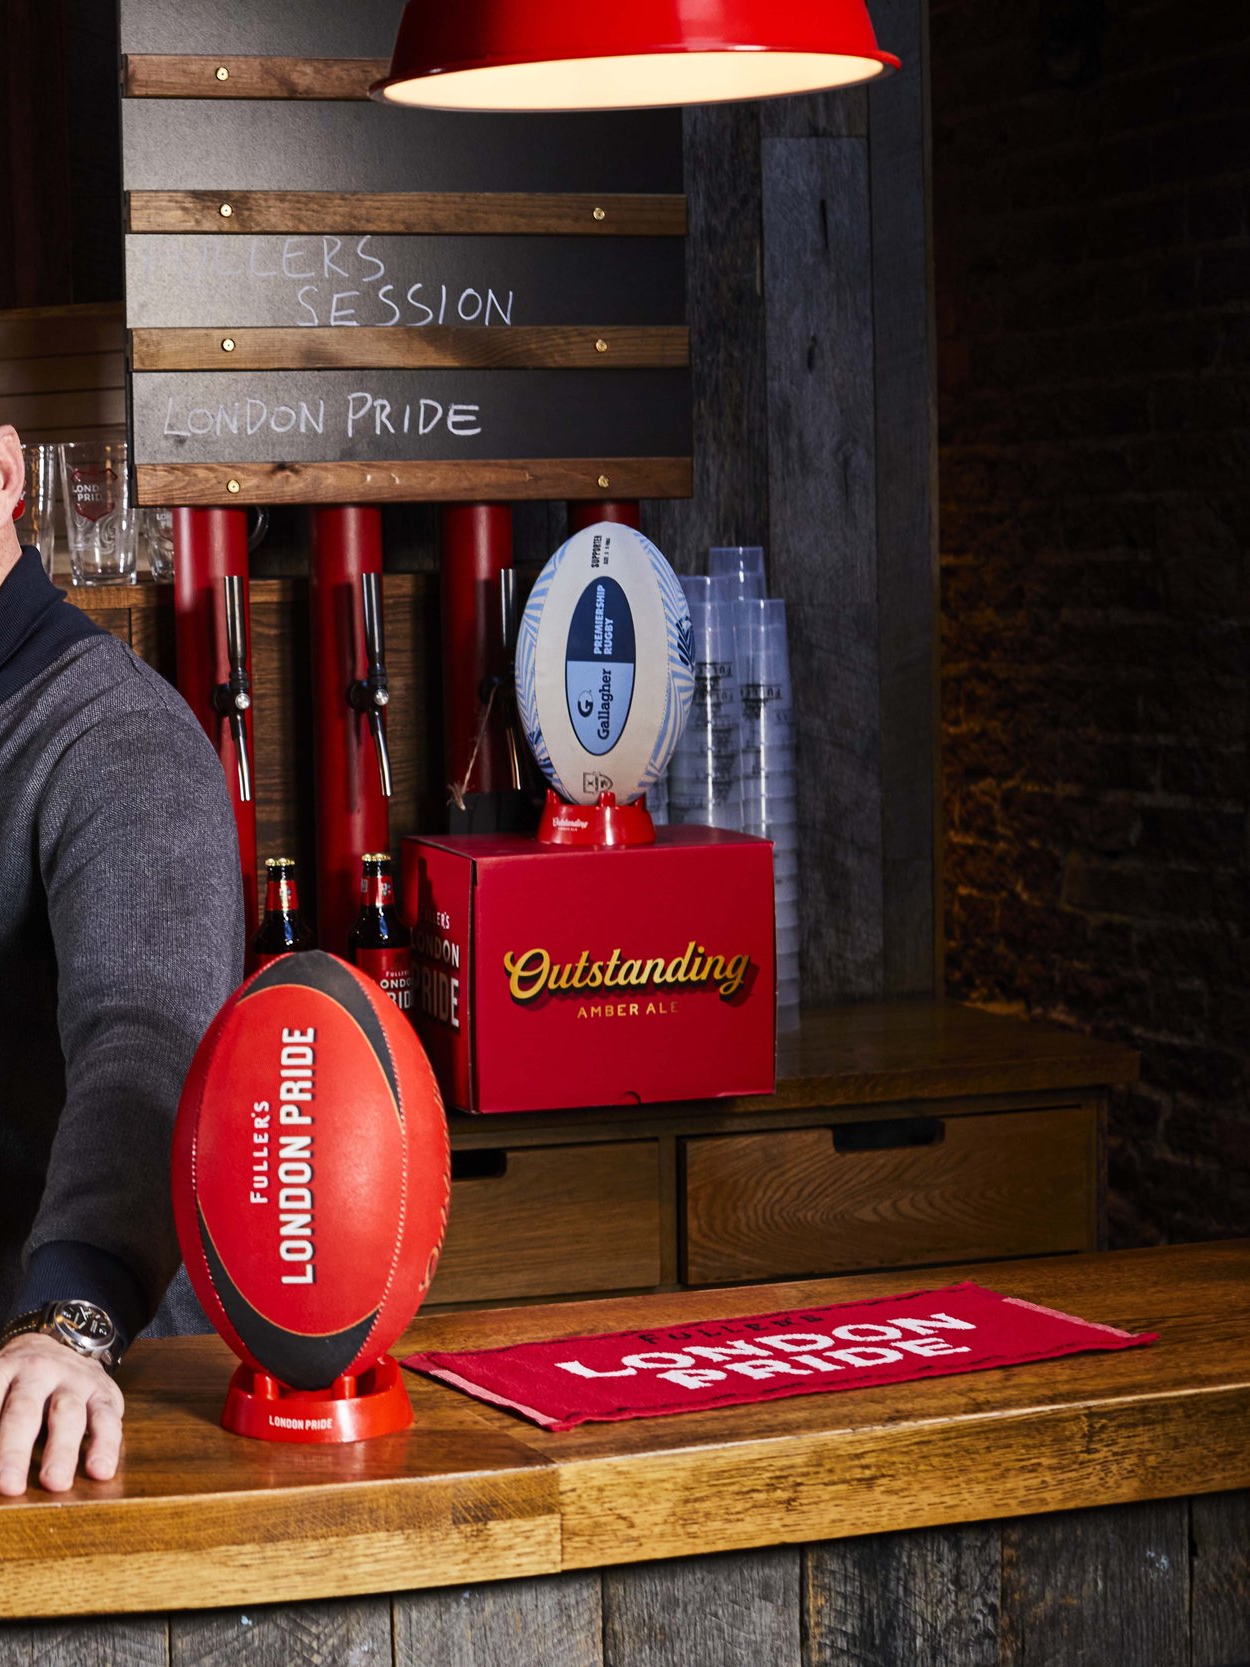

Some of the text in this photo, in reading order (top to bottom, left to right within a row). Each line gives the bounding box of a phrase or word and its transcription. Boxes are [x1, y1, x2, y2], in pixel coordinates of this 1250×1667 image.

[297, 283, 513, 327] SESSION
[163, 391, 482, 438] LONDON PRIDE
[590, 535, 603, 568] SUPPORTER
[593, 584, 606, 655] PREMIERSHIP
[603, 617, 614, 656] RUGBY
[597, 668, 612, 741] Gallagher
[380, 979, 411, 989] ONDO
[411, 962, 460, 1028] PRIDE
[503, 940, 751, 1001] Outstanding
[577, 1001, 679, 1019] AMBER ALE
[250, 1100, 270, 1204] FULLER'S
[278, 1027, 316, 1285] LONDON PRIDE
[554, 1312, 977, 1379] LONDON
[656, 1337, 972, 1390] PRIDE
[269, 1415, 333, 1430] LONDON PRIDE
